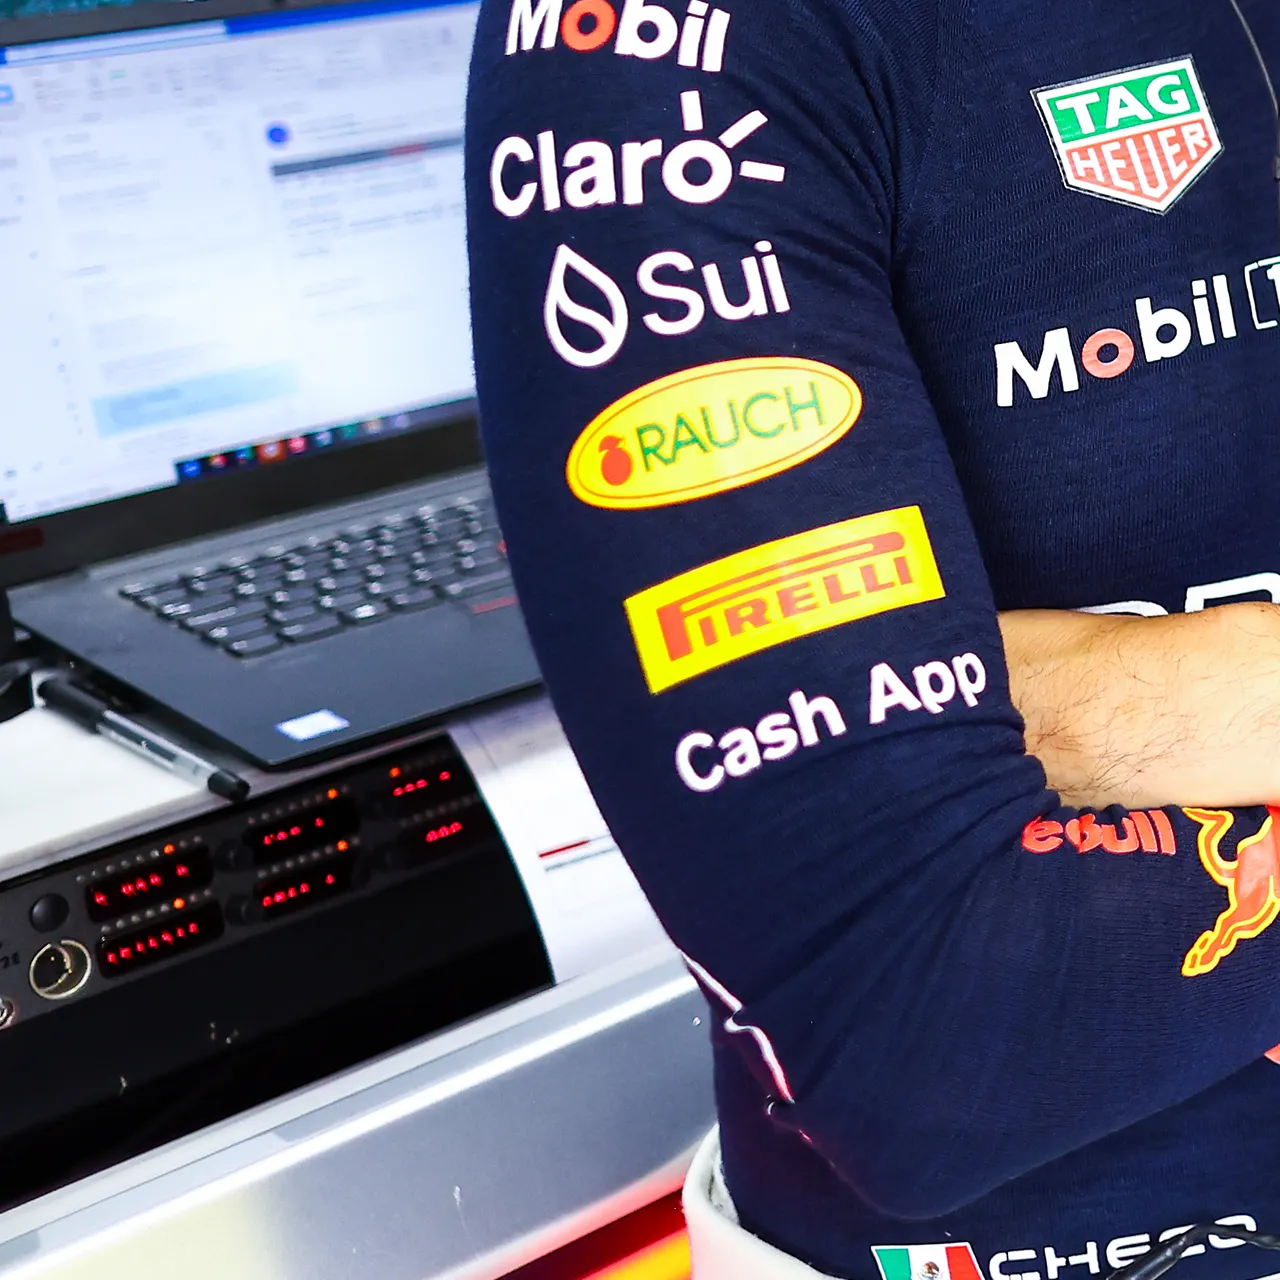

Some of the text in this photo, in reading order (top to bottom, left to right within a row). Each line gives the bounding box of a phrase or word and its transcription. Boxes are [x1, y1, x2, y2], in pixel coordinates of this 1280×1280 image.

[1056, 74, 1191, 135] TAG
[489, 129, 735, 219] Claro
[1071, 121, 1208, 198] HEUER
[636, 239, 791, 336] Sui
[992, 273, 1238, 408] Mobil
[635, 380, 828, 473] RAUCH
[656, 530, 914, 662] PIRELLI
[675, 651, 988, 793] Cash App
